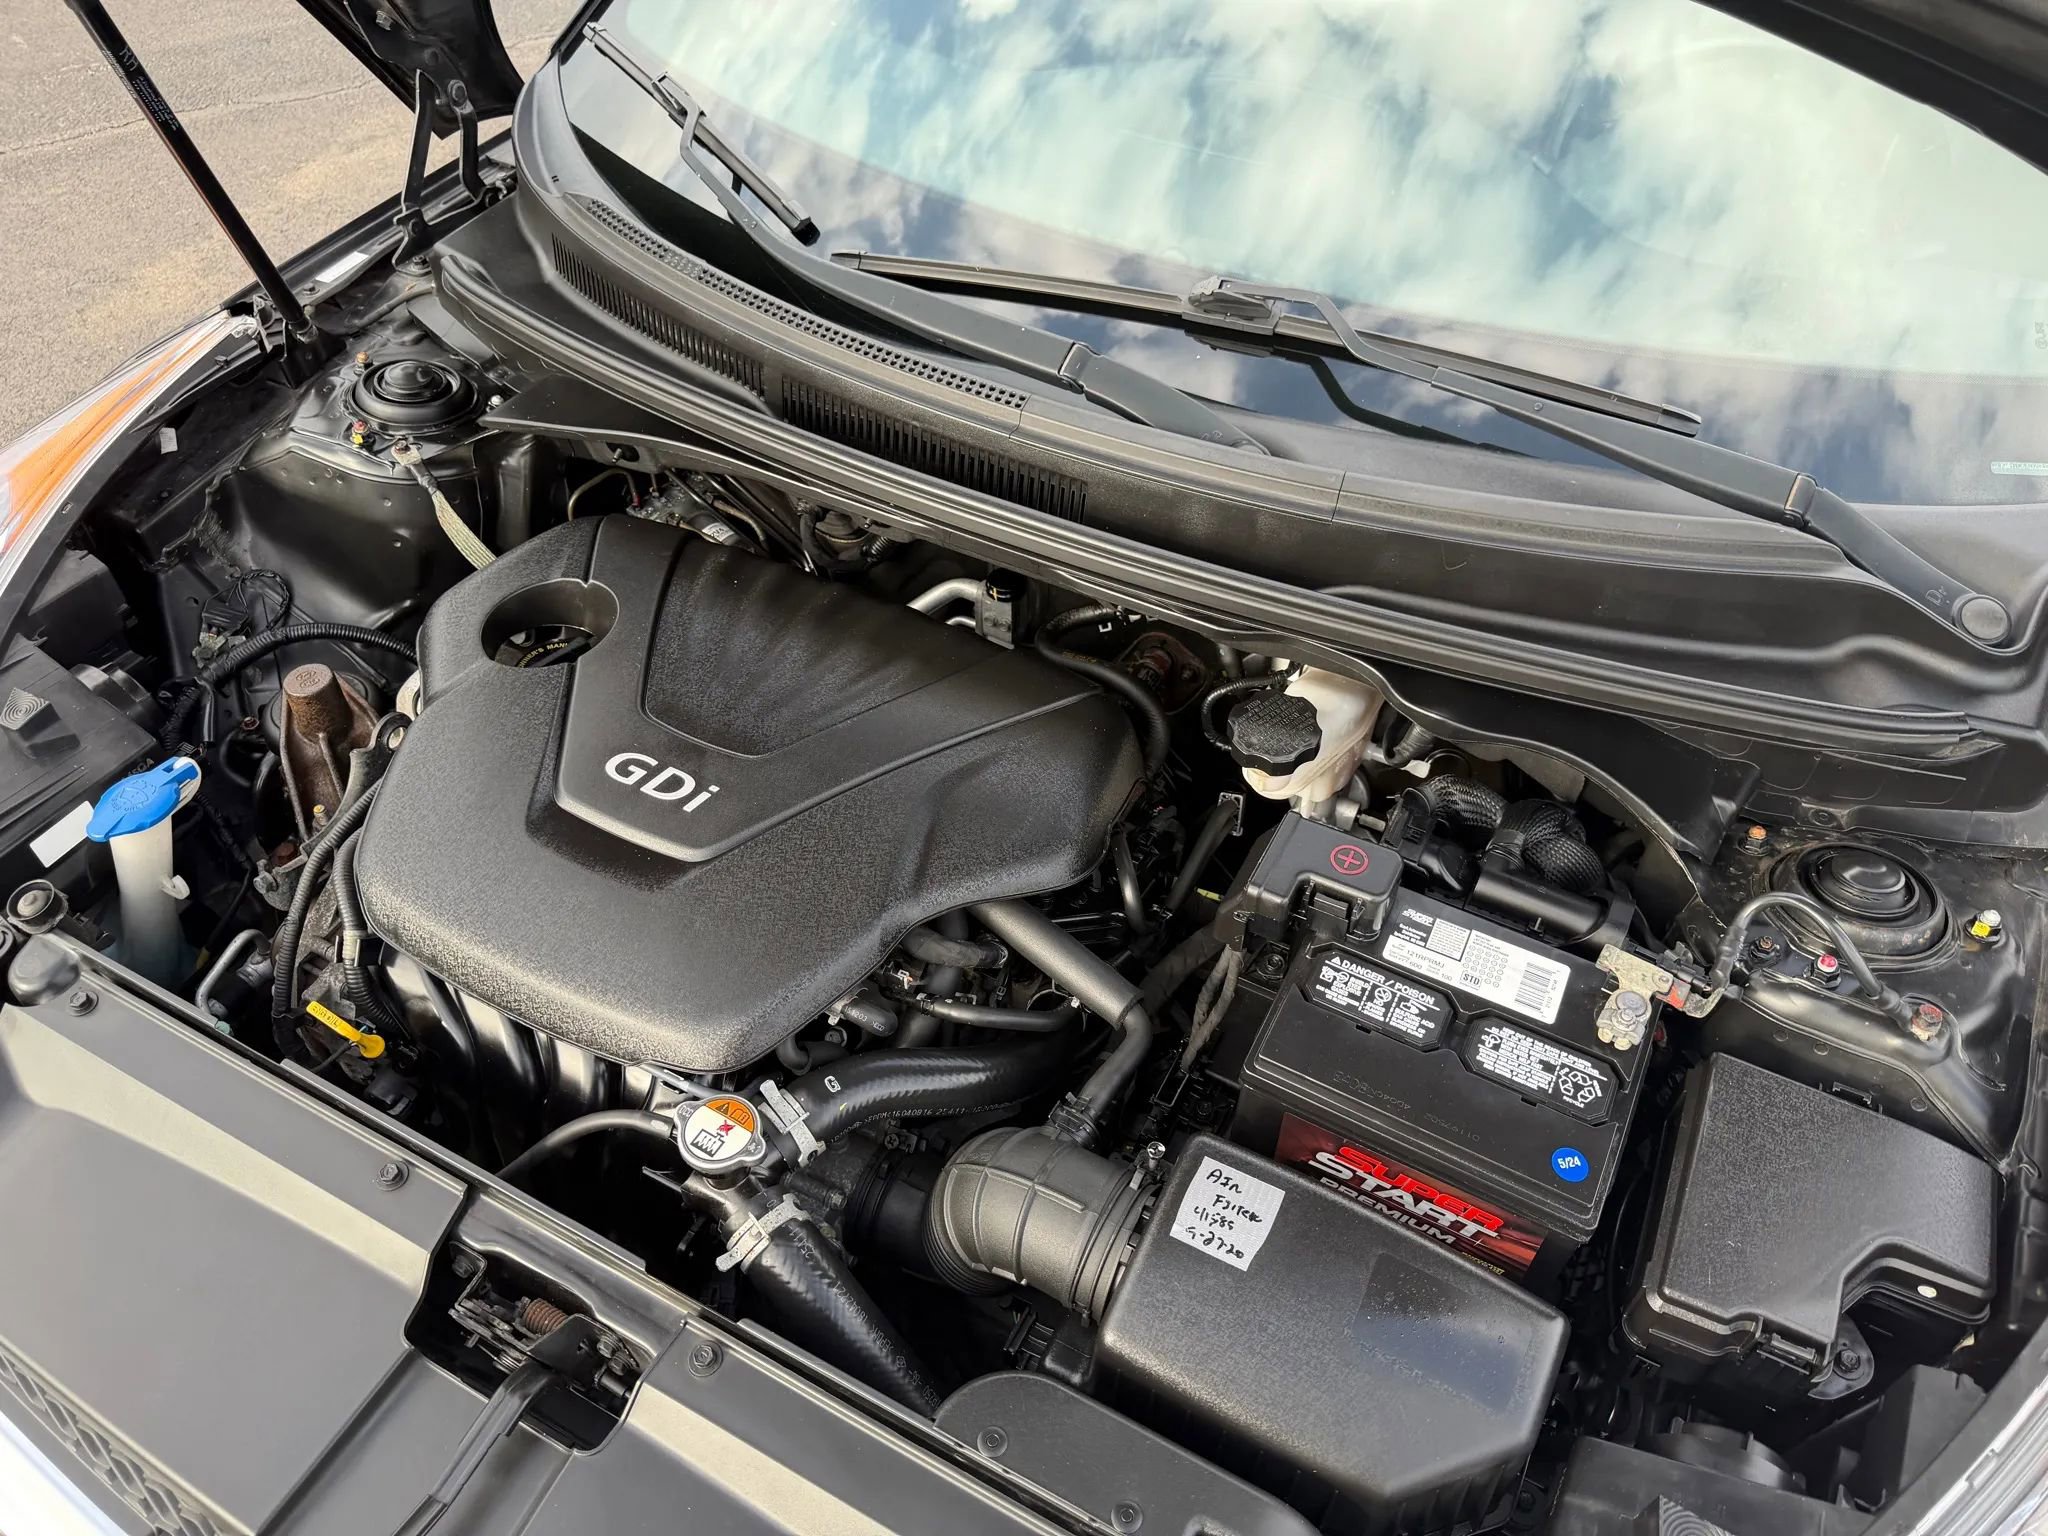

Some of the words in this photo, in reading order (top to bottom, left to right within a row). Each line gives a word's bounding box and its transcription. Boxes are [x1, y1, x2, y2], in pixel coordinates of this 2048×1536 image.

[604, 751, 719, 813] GDi
[1342, 959, 1386, 984] DANGER
[1394, 982, 1435, 1005] POISON
[1462, 973, 1481, 986] STD
[1334, 1145, 1505, 1233] SUPER
[1557, 1155, 1582, 1169] 5/24
[1308, 1151, 1500, 1239] START
[1319, 1175, 1458, 1245] PREMIUM
